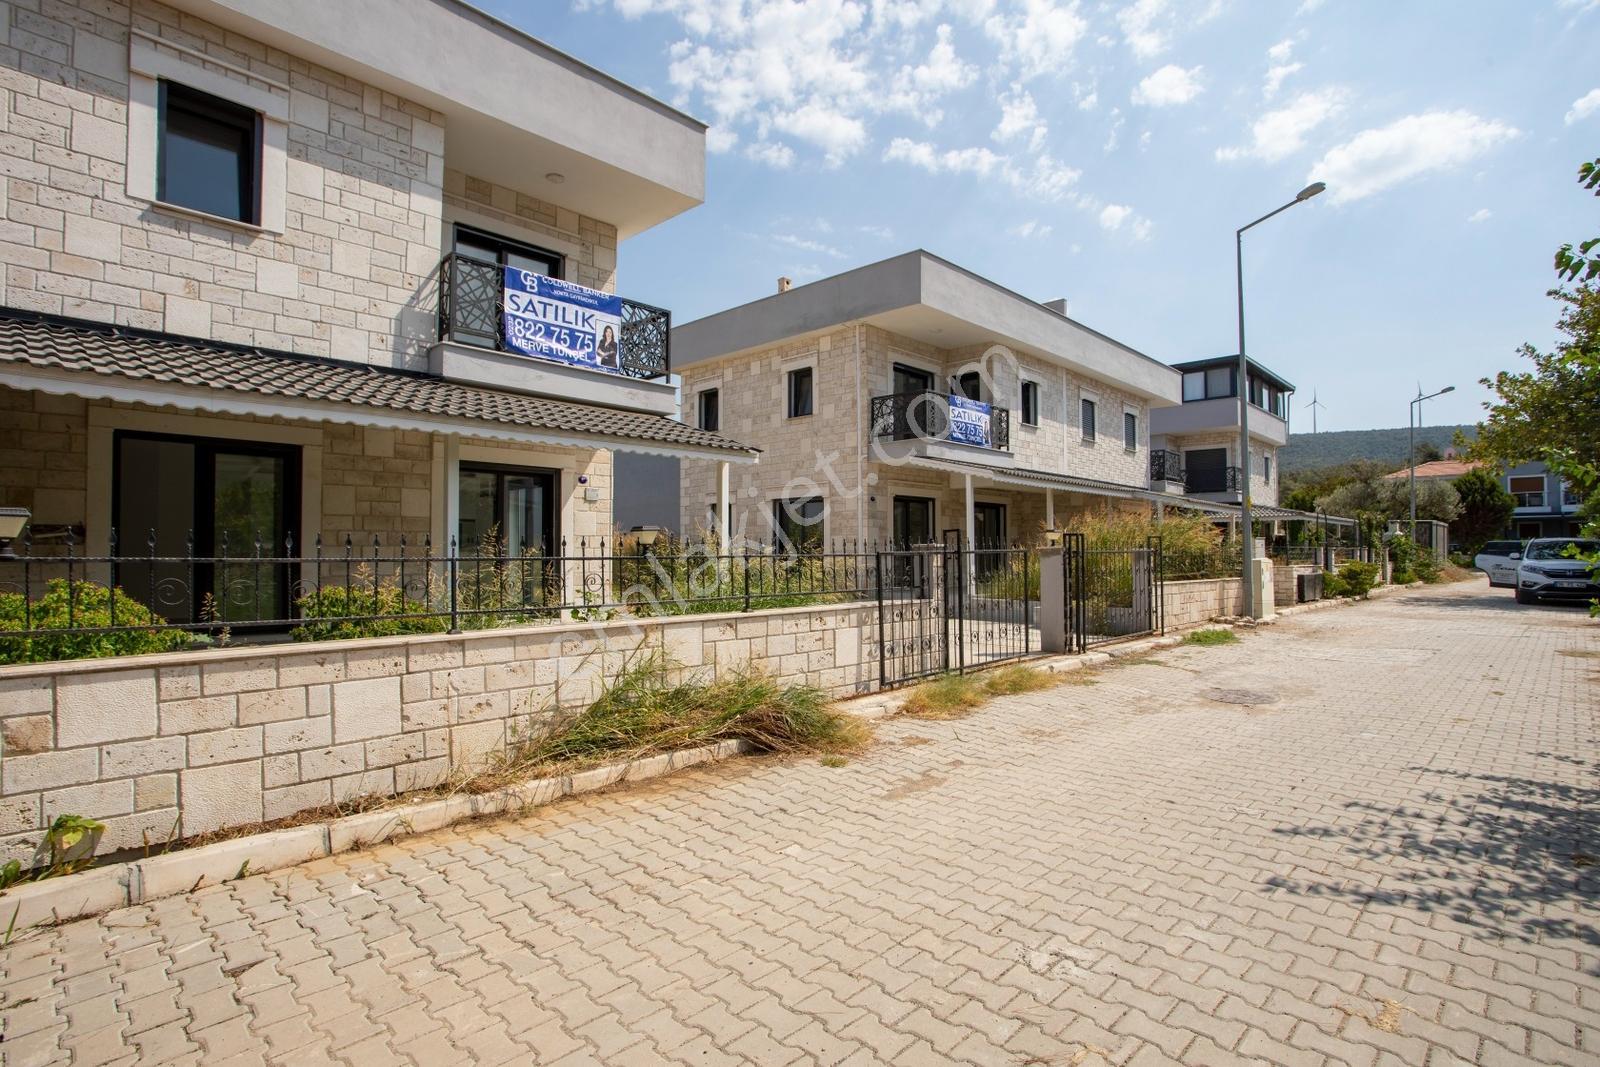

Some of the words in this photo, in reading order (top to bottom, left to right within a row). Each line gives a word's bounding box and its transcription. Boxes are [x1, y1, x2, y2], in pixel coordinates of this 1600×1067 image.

[508, 293, 595, 331] SATILIK
[514, 318, 545, 342] 822
[550, 326, 570, 348] 75
[574, 331, 593, 352] 75
[512, 336, 549, 354] MERVE
[951, 408, 983, 424] SATILIK
[967, 424, 975, 435] 75
[976, 426, 983, 437] 75
